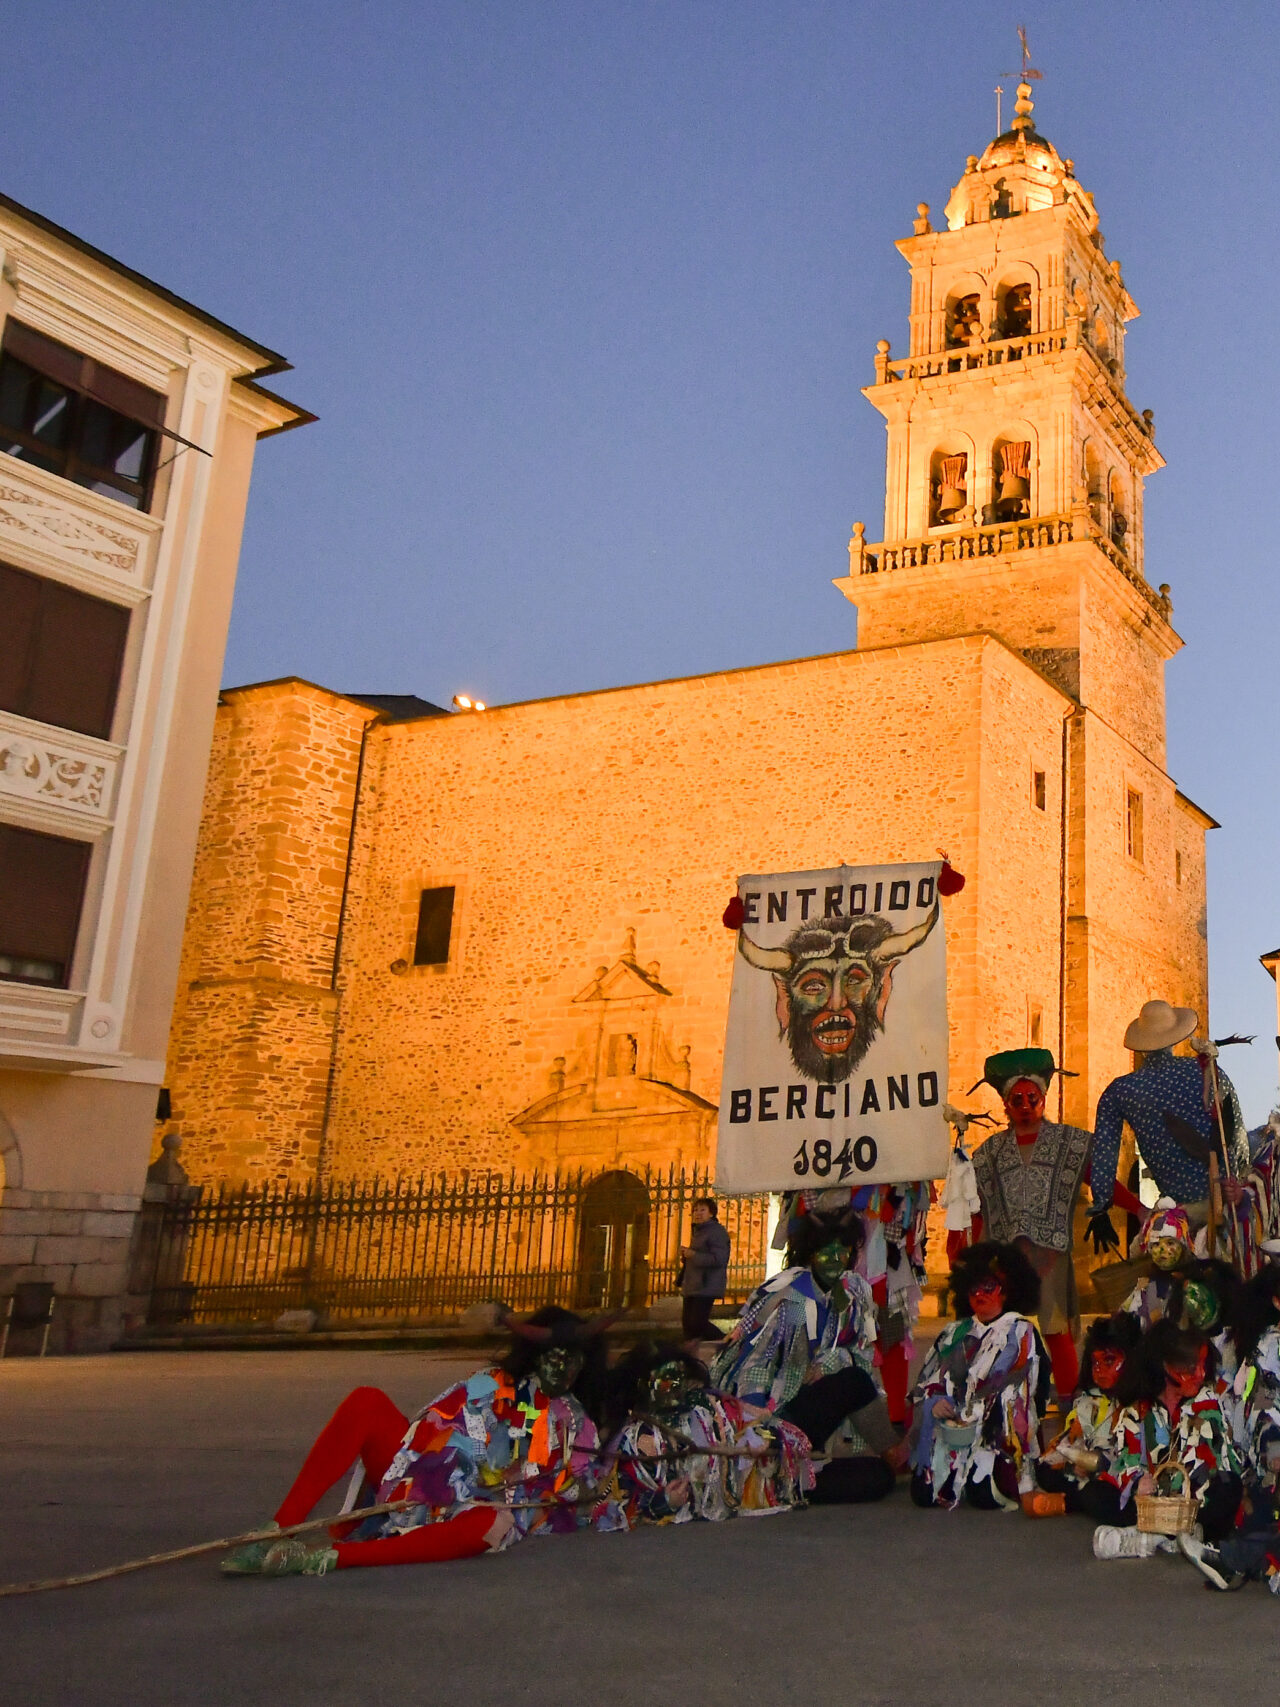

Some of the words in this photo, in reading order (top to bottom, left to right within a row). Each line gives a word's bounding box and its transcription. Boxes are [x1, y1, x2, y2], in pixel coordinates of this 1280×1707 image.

[743, 876, 936, 924] ENTROIDO
[729, 1071, 939, 1124] BERCIANO
[793, 1135, 878, 1183] 1840
